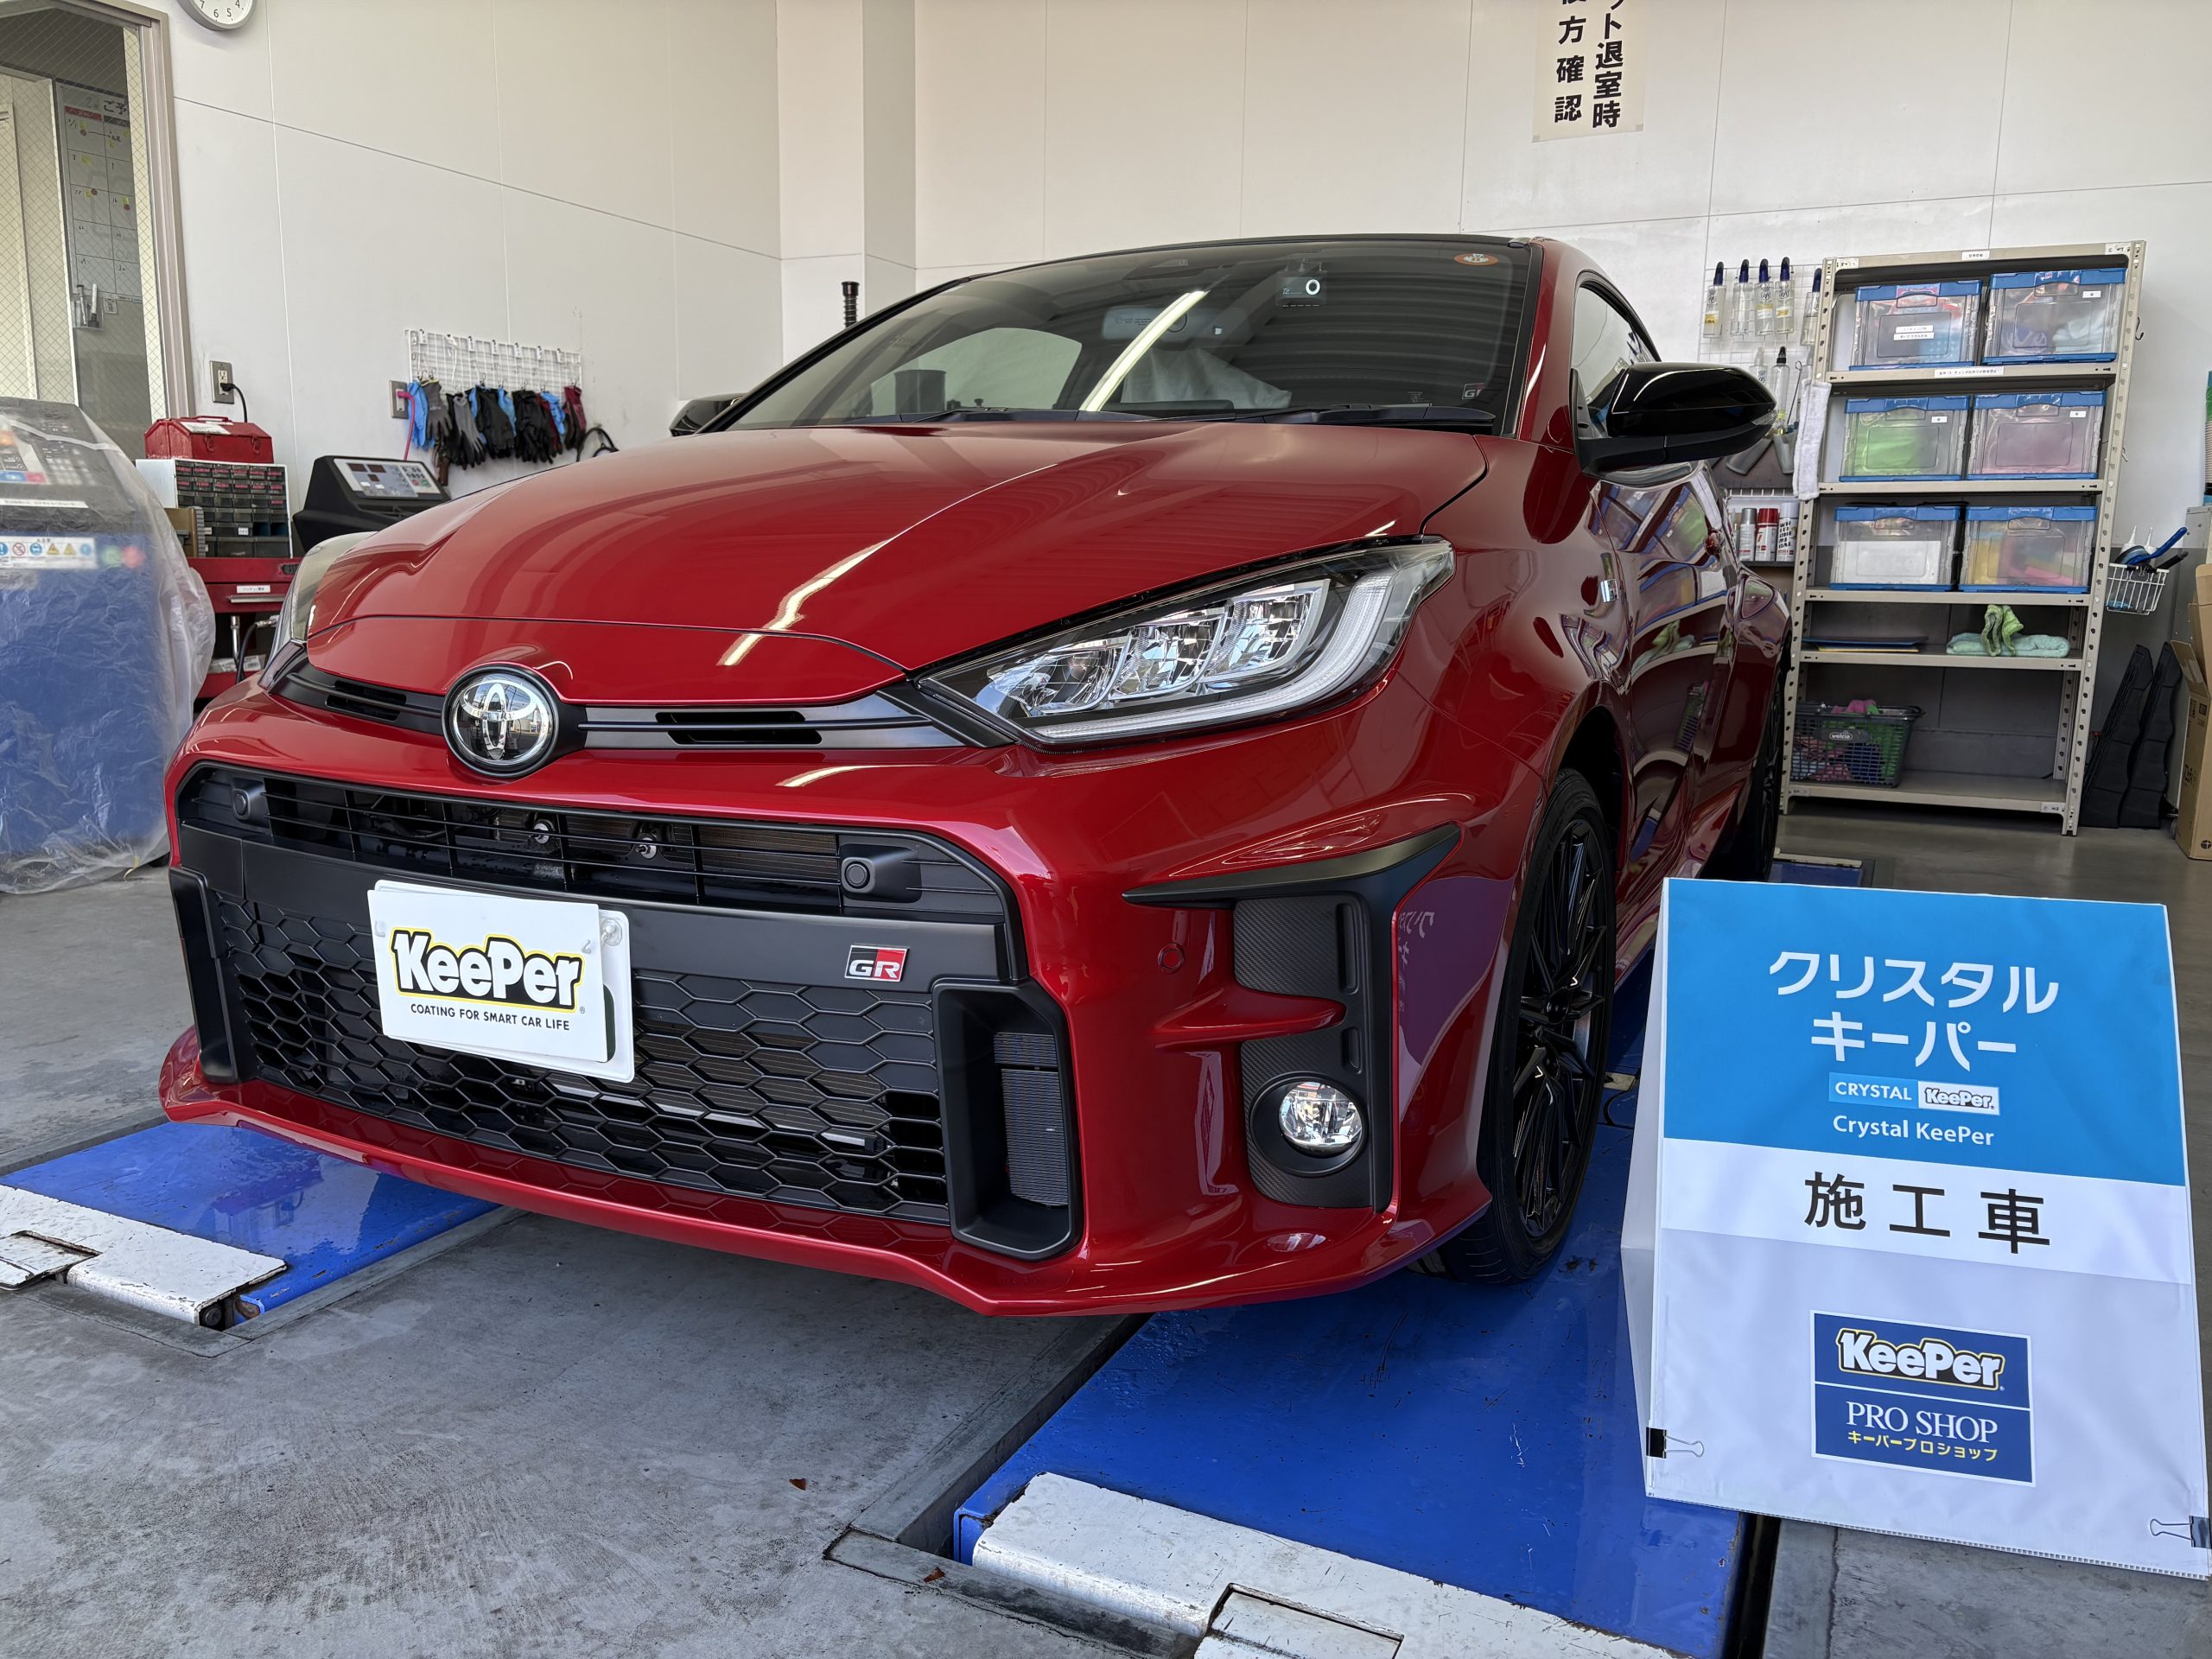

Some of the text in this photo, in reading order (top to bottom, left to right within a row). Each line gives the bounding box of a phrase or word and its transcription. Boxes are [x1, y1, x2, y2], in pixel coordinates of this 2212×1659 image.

[213, 9, 219, 18] 6
[226, 8, 232, 17] 5
[1554, 0, 1586, 123] 方確認
[393, 928, 582, 1011] KeePer
[849, 959, 900, 979] GR
[1770, 951, 2060, 1014] クリスタル
[410, 1002, 570, 1031] COATING FOR SMART CAR LIFE
[1811, 1011, 2017, 1072] キーパー
[1834, 1081, 1994, 1109] CRYSTAL KeePer
[1833, 1115, 1995, 1146] Crystal KeePer
[1803, 1171, 2050, 1255] 施工車
[1837, 1329, 2004, 1389] KeePer
[1846, 1401, 1999, 1443] PRO SHOP
[1847, 1430, 1999, 1462] キーパープロショップ
